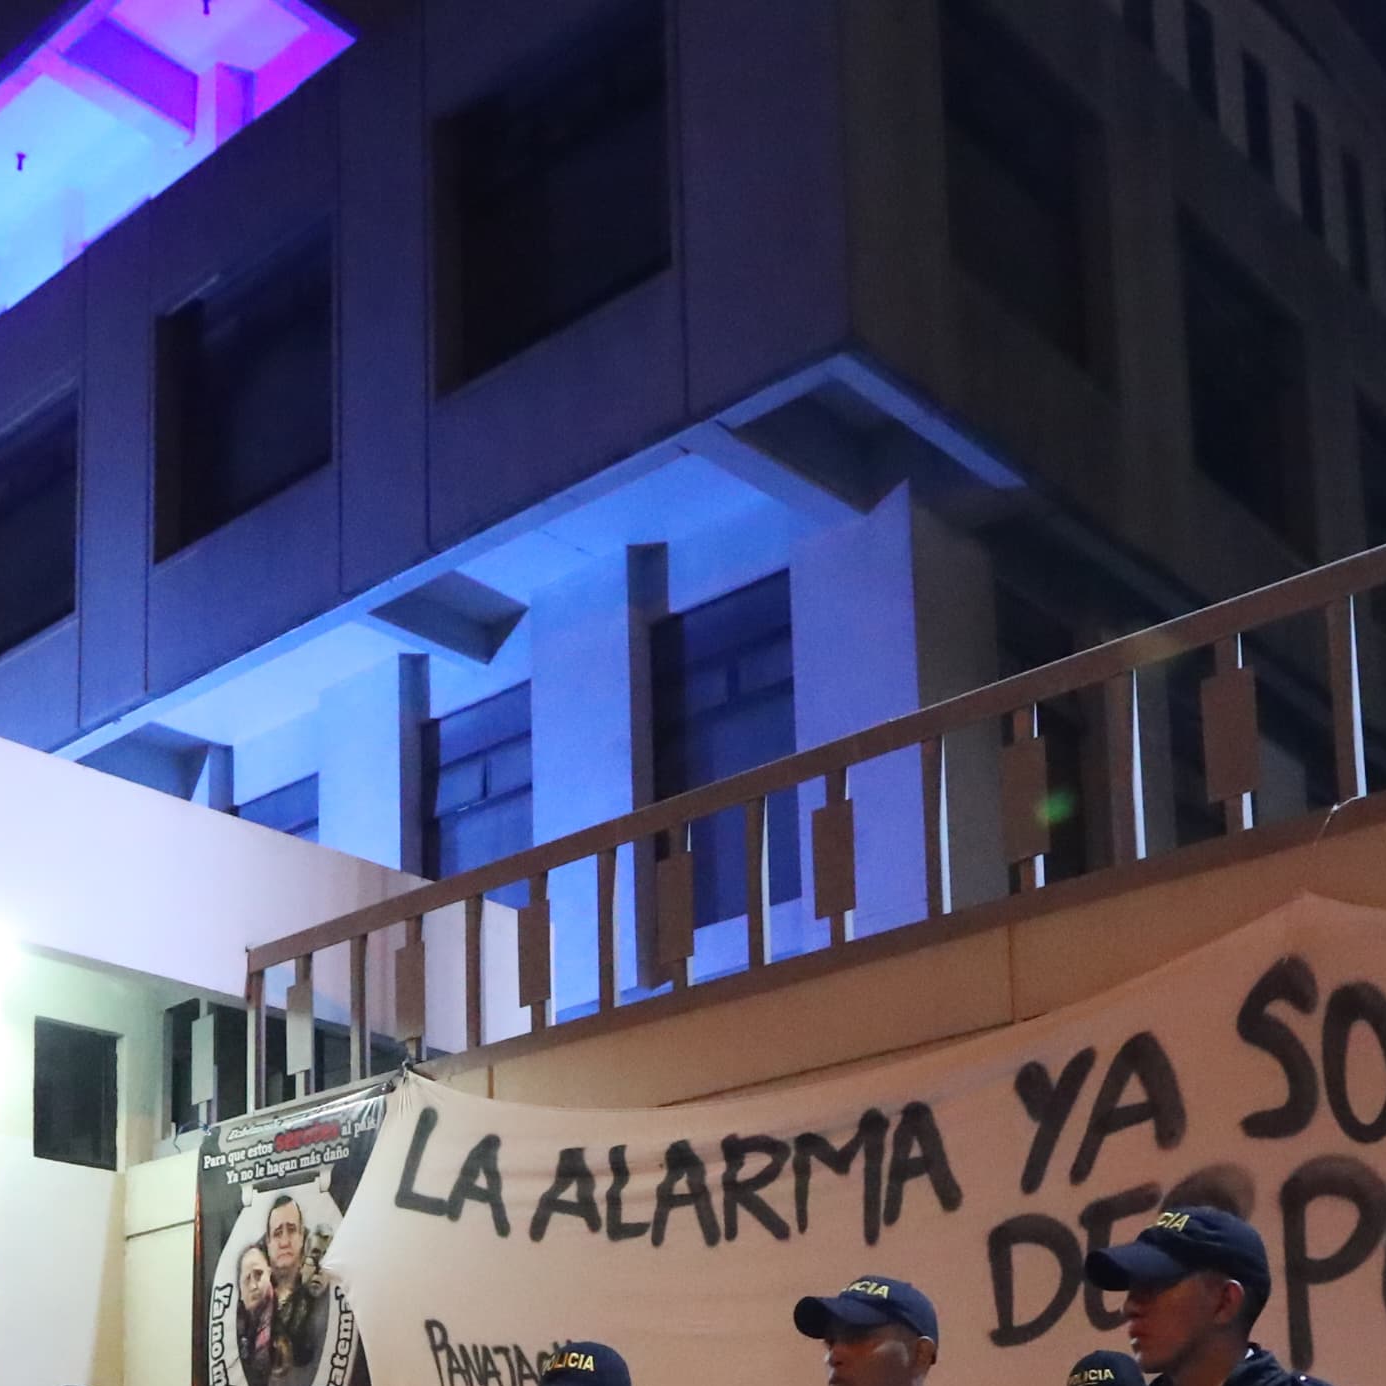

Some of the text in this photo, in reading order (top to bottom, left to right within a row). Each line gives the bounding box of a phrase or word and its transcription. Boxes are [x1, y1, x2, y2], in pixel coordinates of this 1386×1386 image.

[203, 1154, 226, 1169] Para
[227, 1150, 246, 1167] que
[248, 1141, 273, 1158] estos
[341, 1124, 352, 1136] al
[395, 1107, 510, 1238] LA
[530, 1101, 963, 1247] ALARMA
[1015, 1031, 1187, 1194] YA
[226, 1146, 350, 1184] Ya no le hagan más daño
[211, 1322, 225, 1360] no
